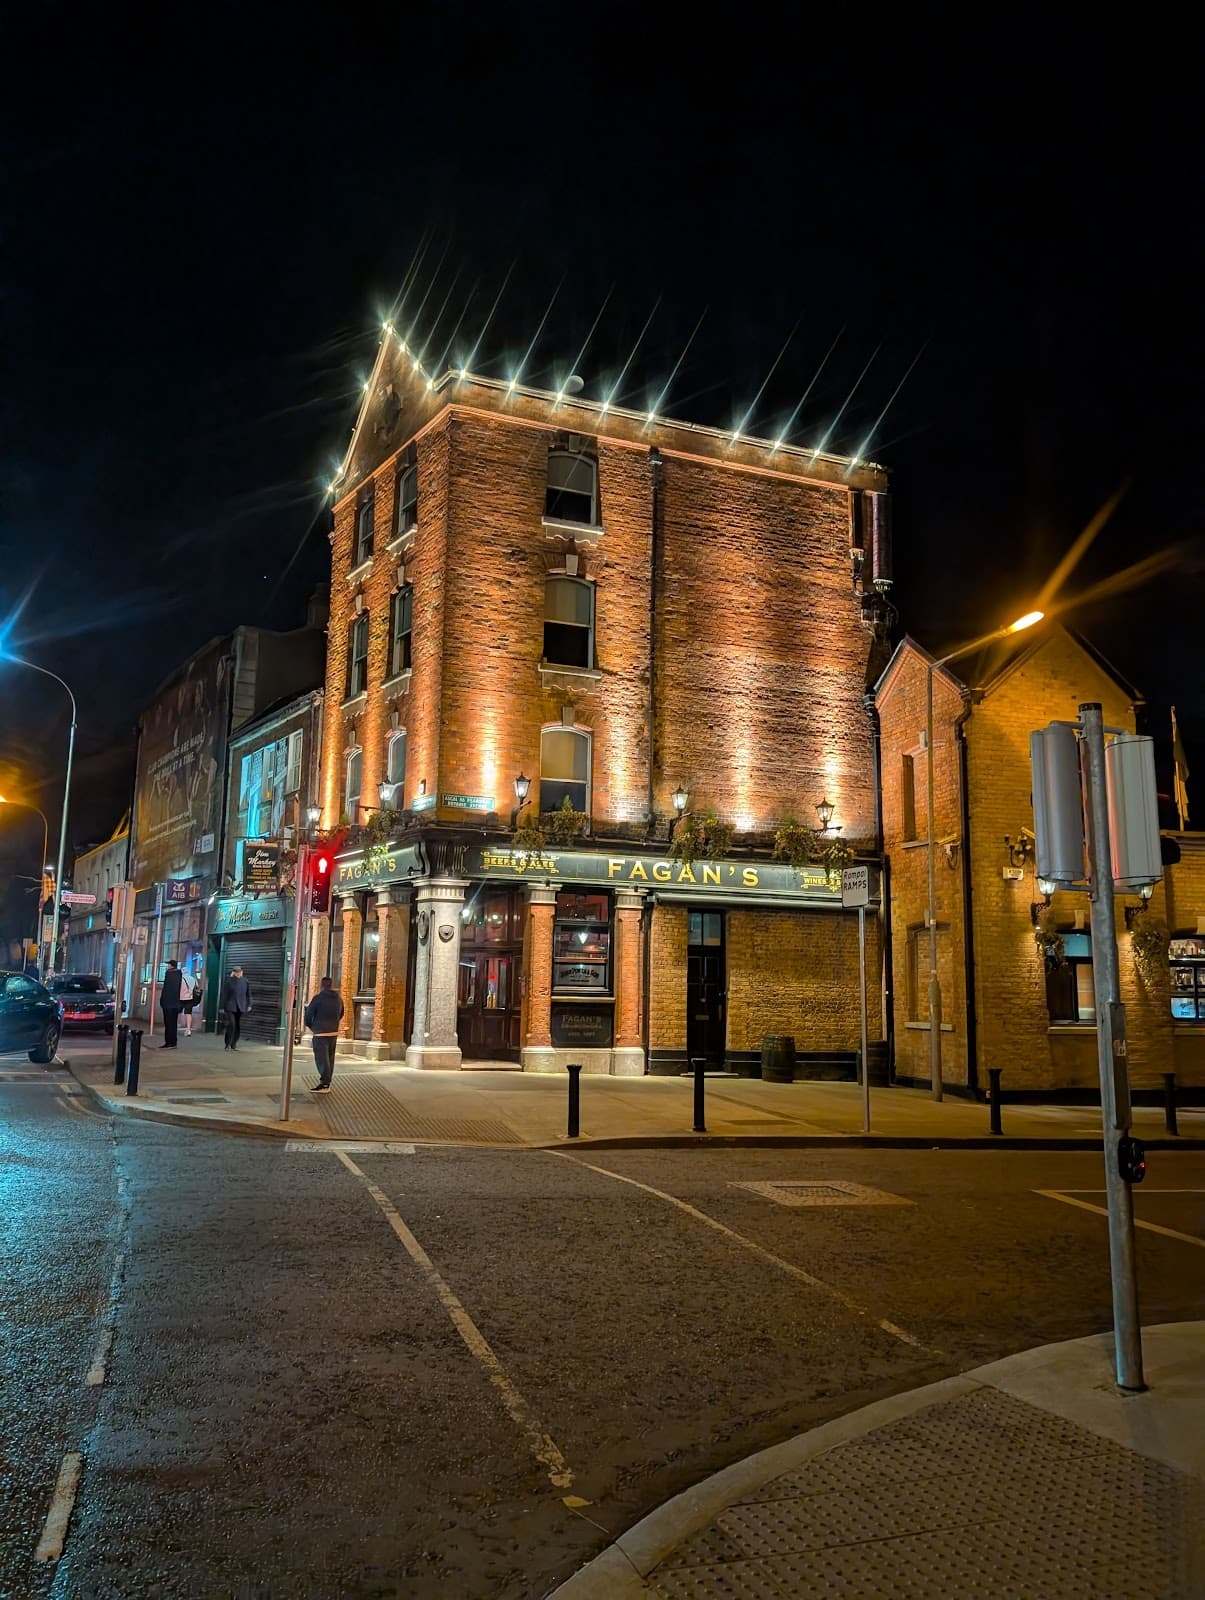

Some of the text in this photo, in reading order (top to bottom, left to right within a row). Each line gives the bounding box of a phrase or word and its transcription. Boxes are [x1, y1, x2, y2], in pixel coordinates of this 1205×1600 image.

[607, 858, 760, 888] FAGAN'S
[844, 880, 867, 891] RAMPS
[171, 891, 185, 899] AIB
